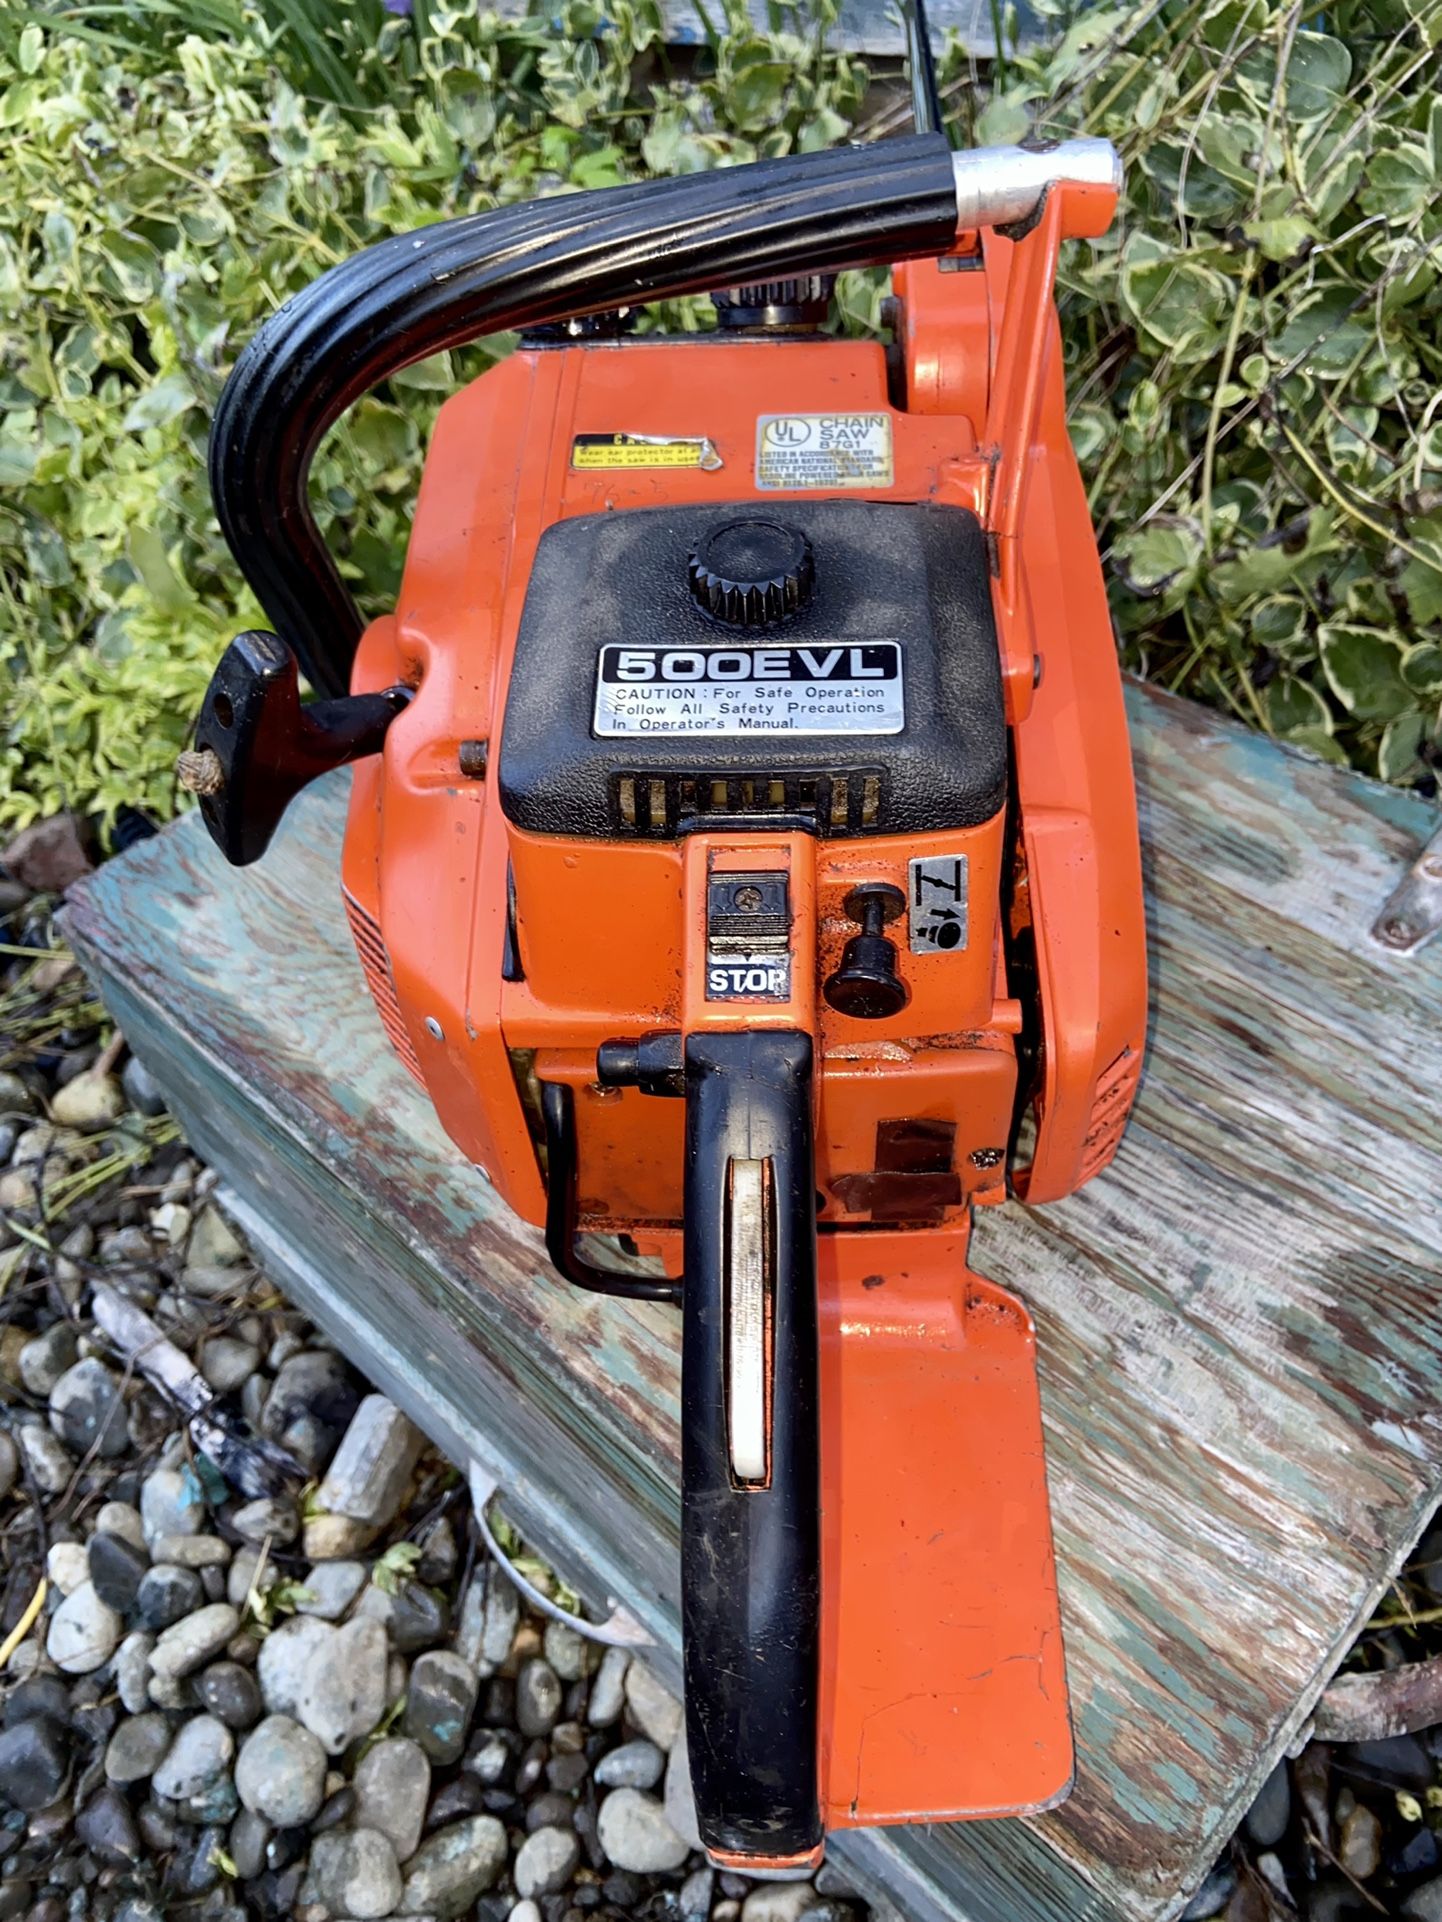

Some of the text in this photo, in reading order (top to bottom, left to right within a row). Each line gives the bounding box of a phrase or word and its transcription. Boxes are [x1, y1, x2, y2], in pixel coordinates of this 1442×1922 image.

[819, 418, 884, 429] CHAIN
[820, 429, 870, 440] SAW
[616, 648, 885, 681] 500EVL
[713, 688, 741, 699] For
[754, 687, 793, 698] Safe
[805, 686, 885, 700] Operation
[613, 701, 885, 715] Follow All Safety Precautions
[612, 719, 626, 729] In
[738, 717, 799, 729] Manual.
[709, 968, 787, 992] STOP
